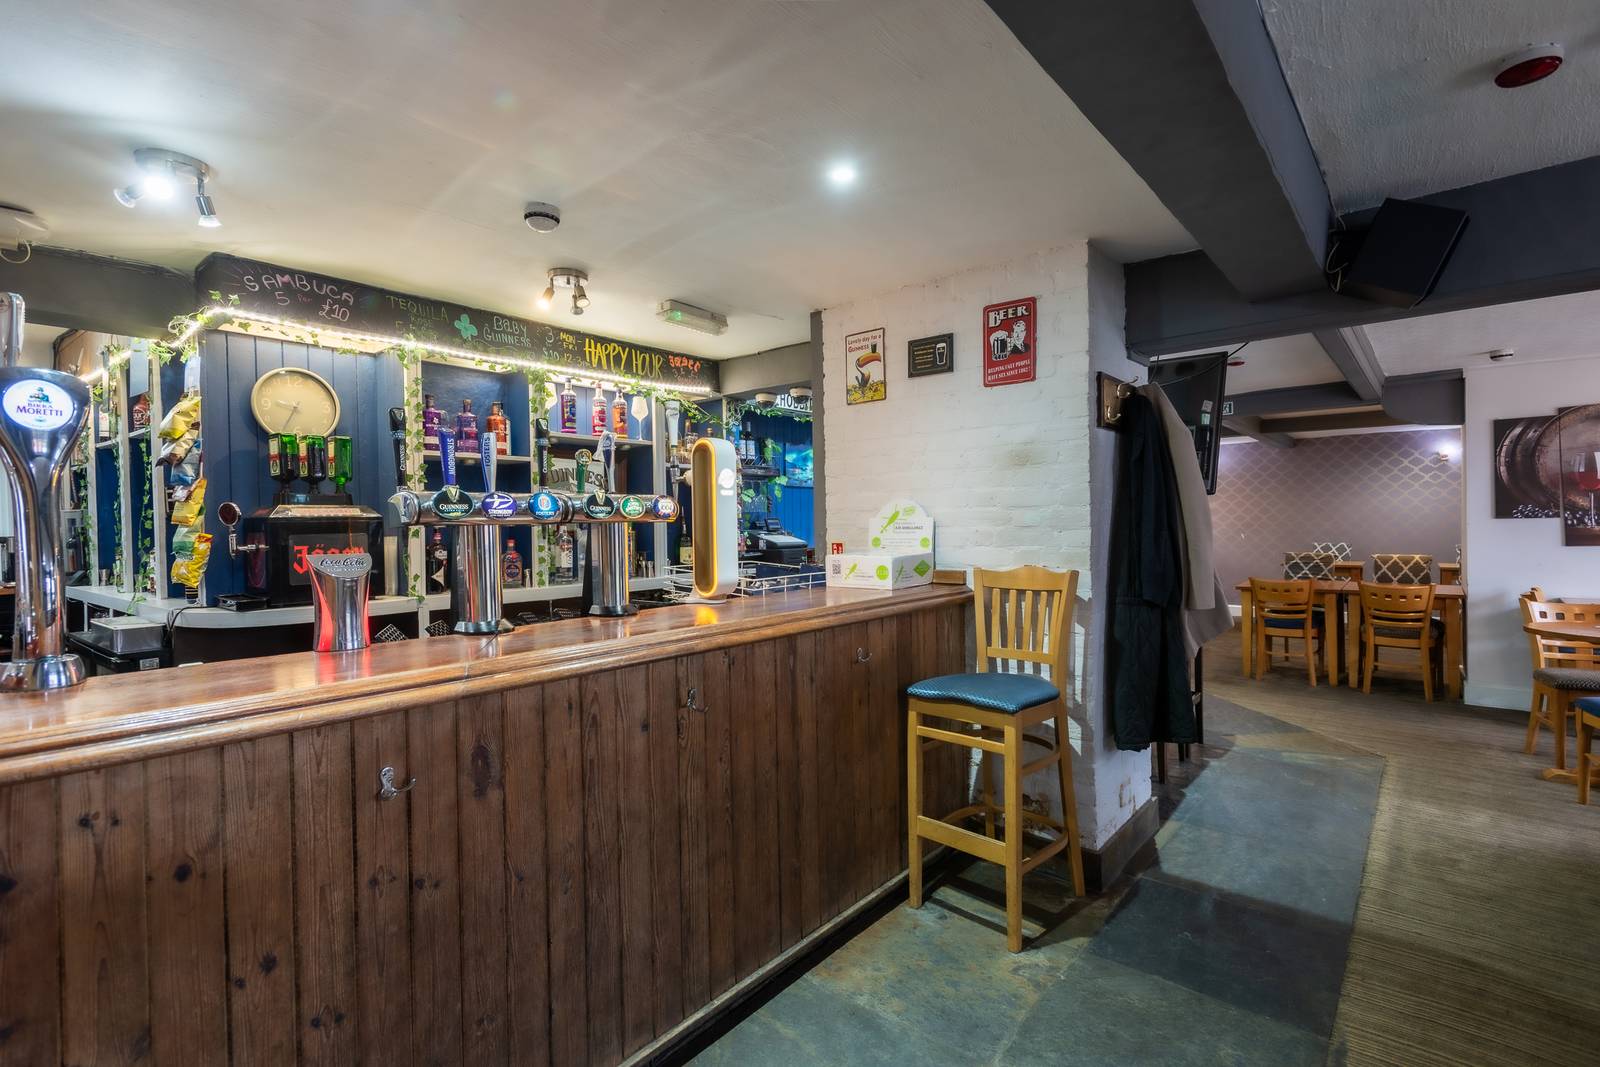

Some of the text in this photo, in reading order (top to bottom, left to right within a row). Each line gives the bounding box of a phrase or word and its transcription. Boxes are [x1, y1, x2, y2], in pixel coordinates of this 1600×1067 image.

[243, 274, 354, 306] SAMBUCA
[275, 291, 290, 306] 5
[318, 298, 350, 322] £10
[386, 295, 449, 323] TEQUILA
[988, 305, 1030, 328] BEER
[483, 326, 532, 348] GUINNESS
[543, 326, 555, 343] 3
[559, 331, 576, 345] MON
[584, 337, 629, 372] HAPPY
[631, 348, 663, 380] HOUR
[286, 375, 303, 388] 12
[16, 405, 63, 417] MORETTI
[261, 398, 272, 411] 9
[446, 438, 456, 475] STRONGBOW
[439, 503, 469, 511] GUINNESS
[589, 504, 612, 513] GUINNESS
